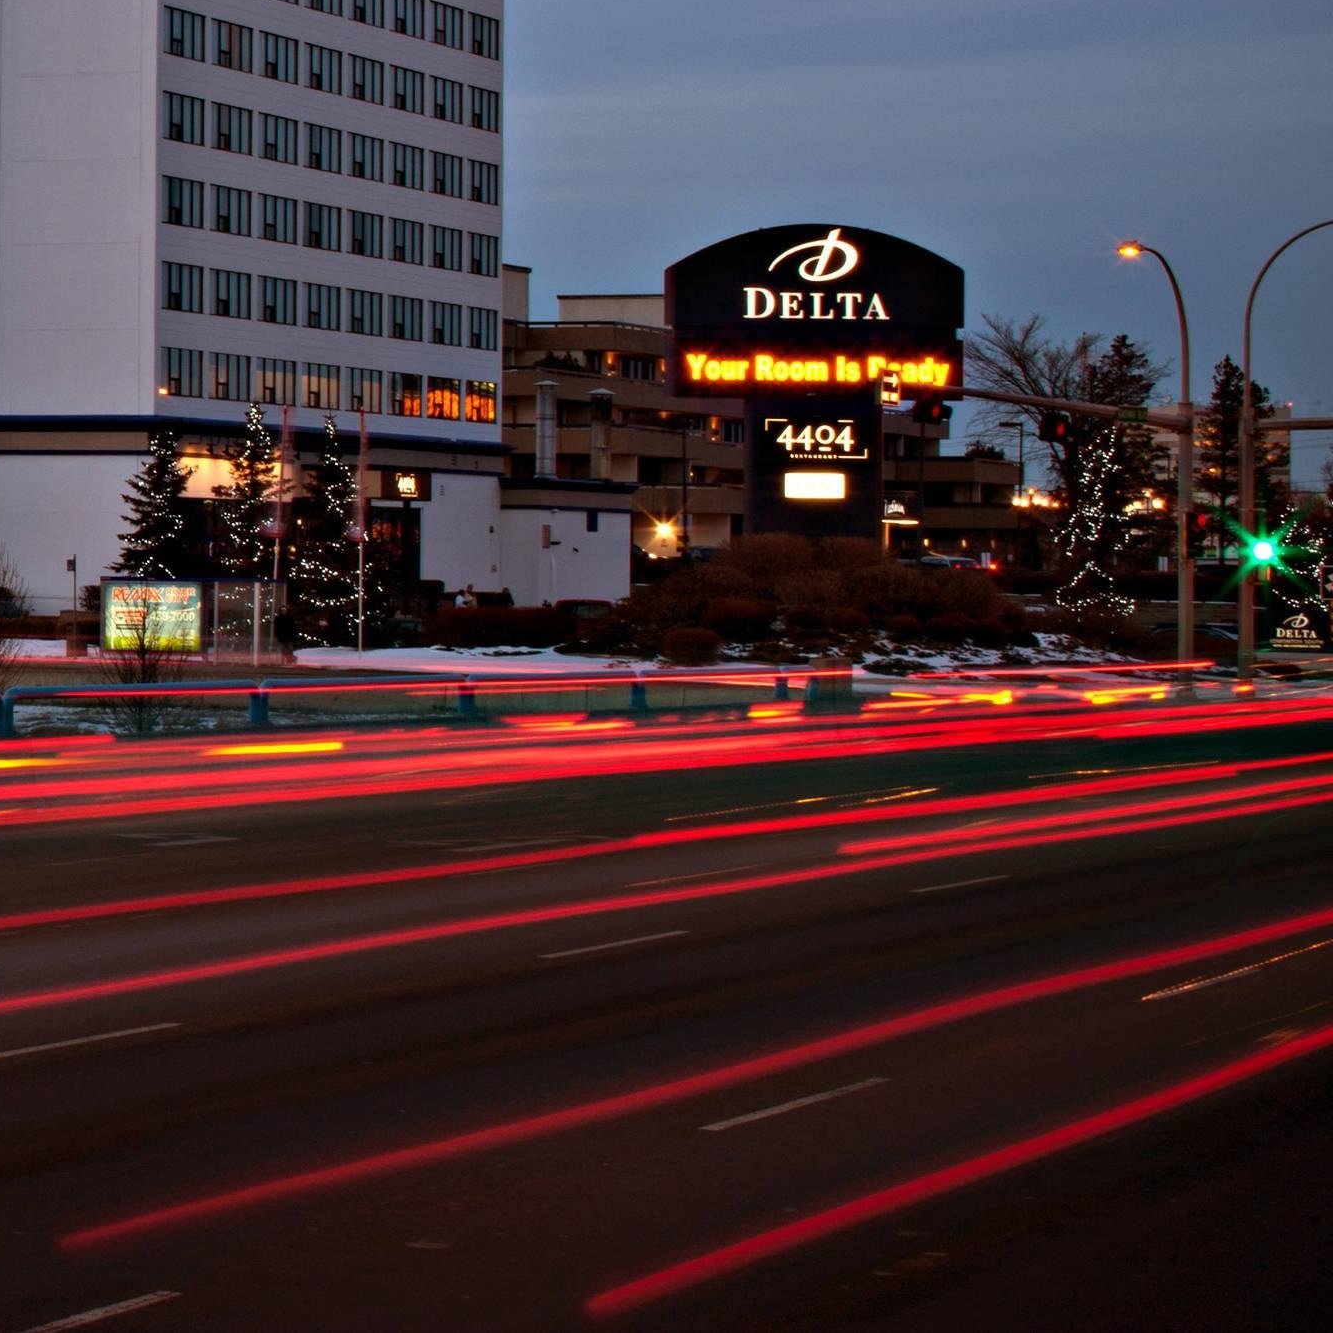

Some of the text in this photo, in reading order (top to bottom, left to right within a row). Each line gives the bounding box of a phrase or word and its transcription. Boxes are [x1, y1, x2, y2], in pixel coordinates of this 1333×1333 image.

[742, 287, 891, 320] DELTA
[686, 354, 749, 380] Your
[755, 355, 829, 381] Room
[836, 356, 861, 382] Is
[776, 424, 855, 452] 4404
[1276, 627, 1318, 639] DELTA
